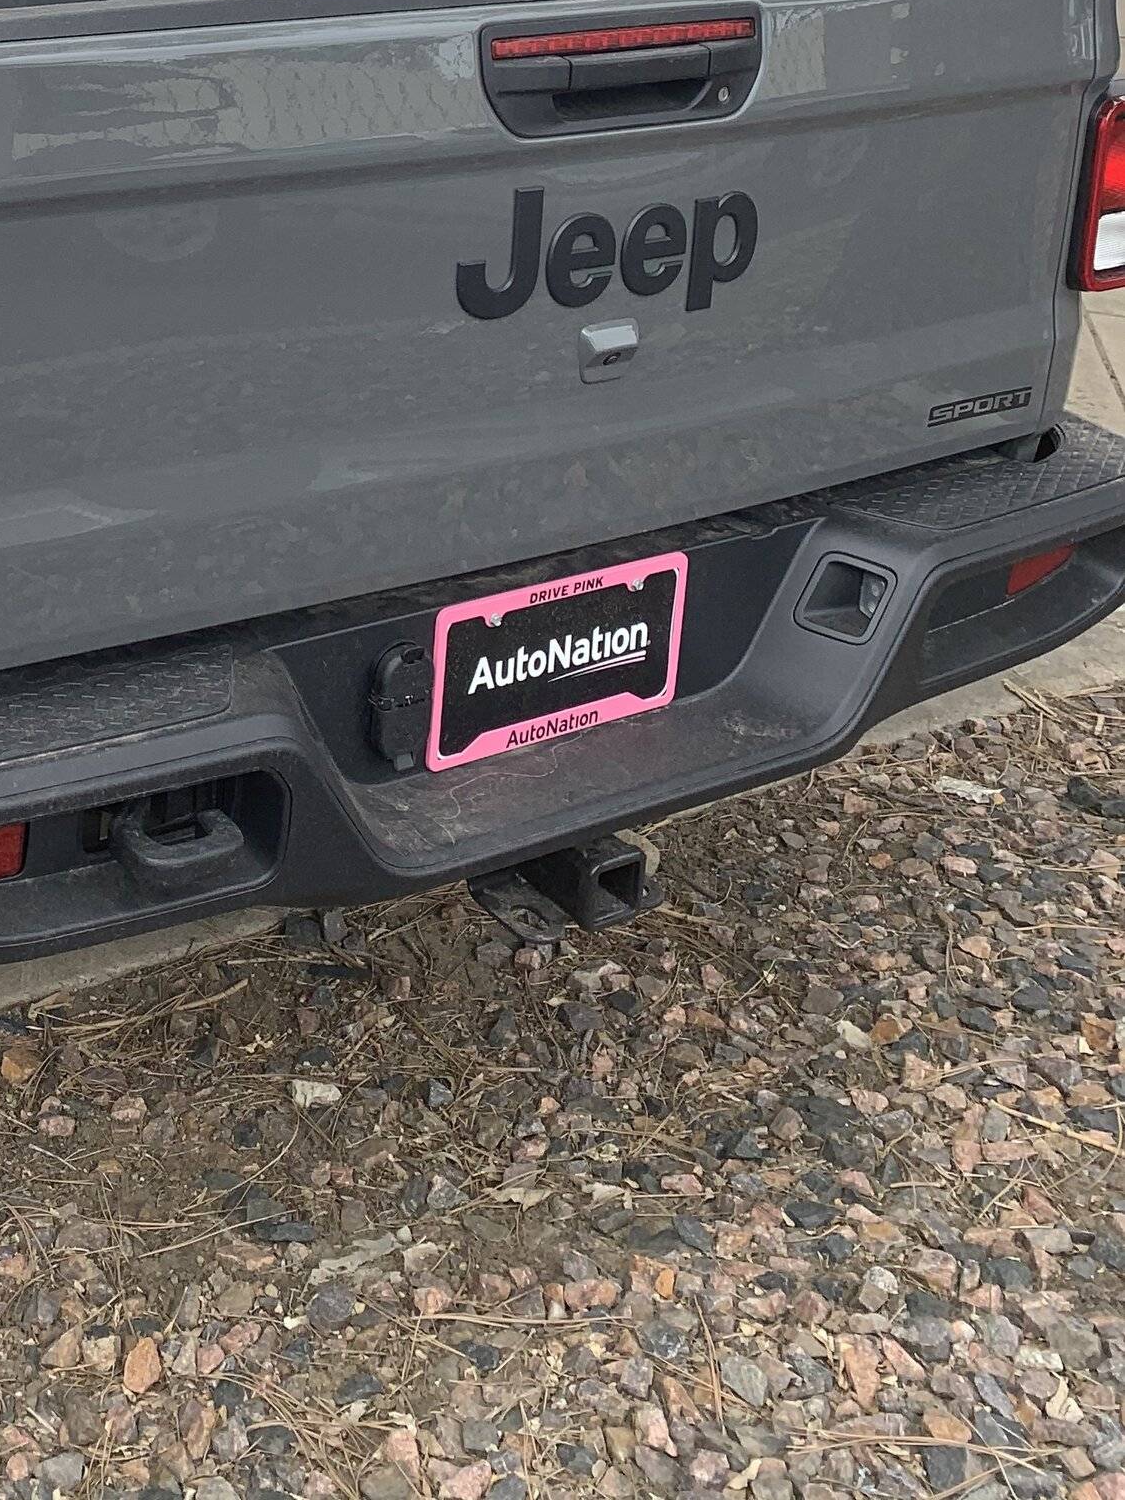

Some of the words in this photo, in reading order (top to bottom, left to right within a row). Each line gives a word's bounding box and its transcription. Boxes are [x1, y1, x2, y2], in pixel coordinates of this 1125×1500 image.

[456, 187, 758, 319] Jeep
[928, 389, 1032, 424] SPORT
[530, 585, 569, 604] DRIVE
[573, 576, 604, 593] PINK
[467, 621, 648, 695] AutoNation
[506, 710, 598, 748] AutoNation
